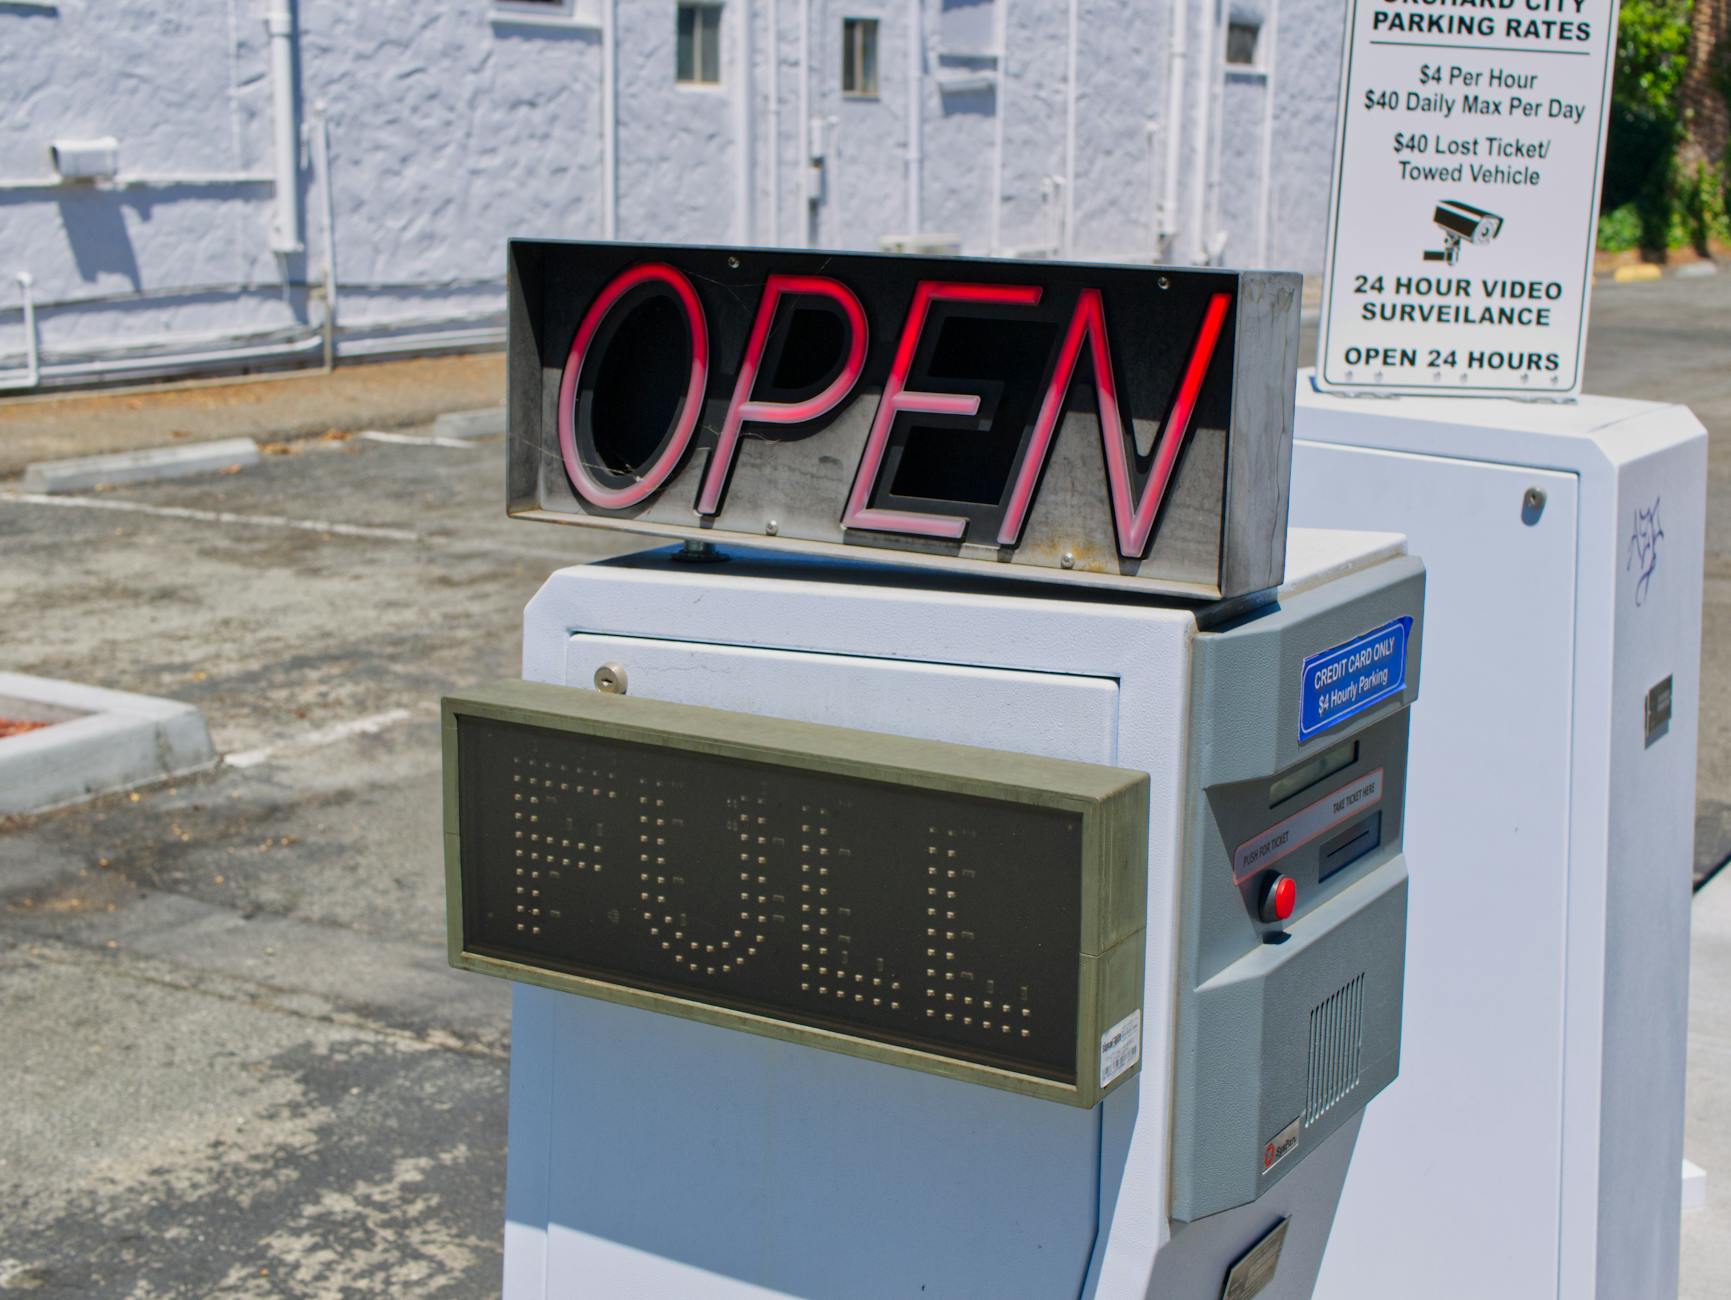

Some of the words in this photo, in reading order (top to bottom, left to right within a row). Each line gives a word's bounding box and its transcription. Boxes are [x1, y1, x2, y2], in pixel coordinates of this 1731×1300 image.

[1373, 11, 1494, 36] PARKING
[1506, 18, 1591, 41] RATES
[1419, 64, 1442, 85] $4
[1450, 66, 1483, 86] Per
[1489, 68, 1538, 89] Hour
[1364, 89, 1399, 110] $40
[1406, 92, 1455, 118] Daily
[1462, 95, 1502, 115] Max
[1509, 97, 1542, 117] Per
[1549, 98, 1586, 124] Day
[1393, 132, 1428, 154] $40
[1435, 135, 1479, 155] Lost
[1486, 137, 1551, 159] Ticket/
[1399, 160, 1463, 182] Towed
[1469, 163, 1541, 185] Vehicle
[1354, 275, 1384, 294] 24
[1395, 276, 1471, 297] HOUR
[1482, 280, 1562, 300] VIDEO
[1361, 302, 1551, 326] SURVEILANCE
[1344, 347, 1417, 367] OPEN
[1427, 349, 1457, 368] 24
[1468, 351, 1559, 371] HOURS
[558, 262, 1231, 558] OPEN
[1315, 659, 1347, 689] CREDIT
[1348, 647, 1372, 673] CARD
[1373, 636, 1395, 661] ONLY
[1318, 694, 1329, 717] $4
[1331, 680, 1358, 708] Hourly
[1359, 668, 1388, 694] Parking
[513, 757, 1030, 1037] FULL
